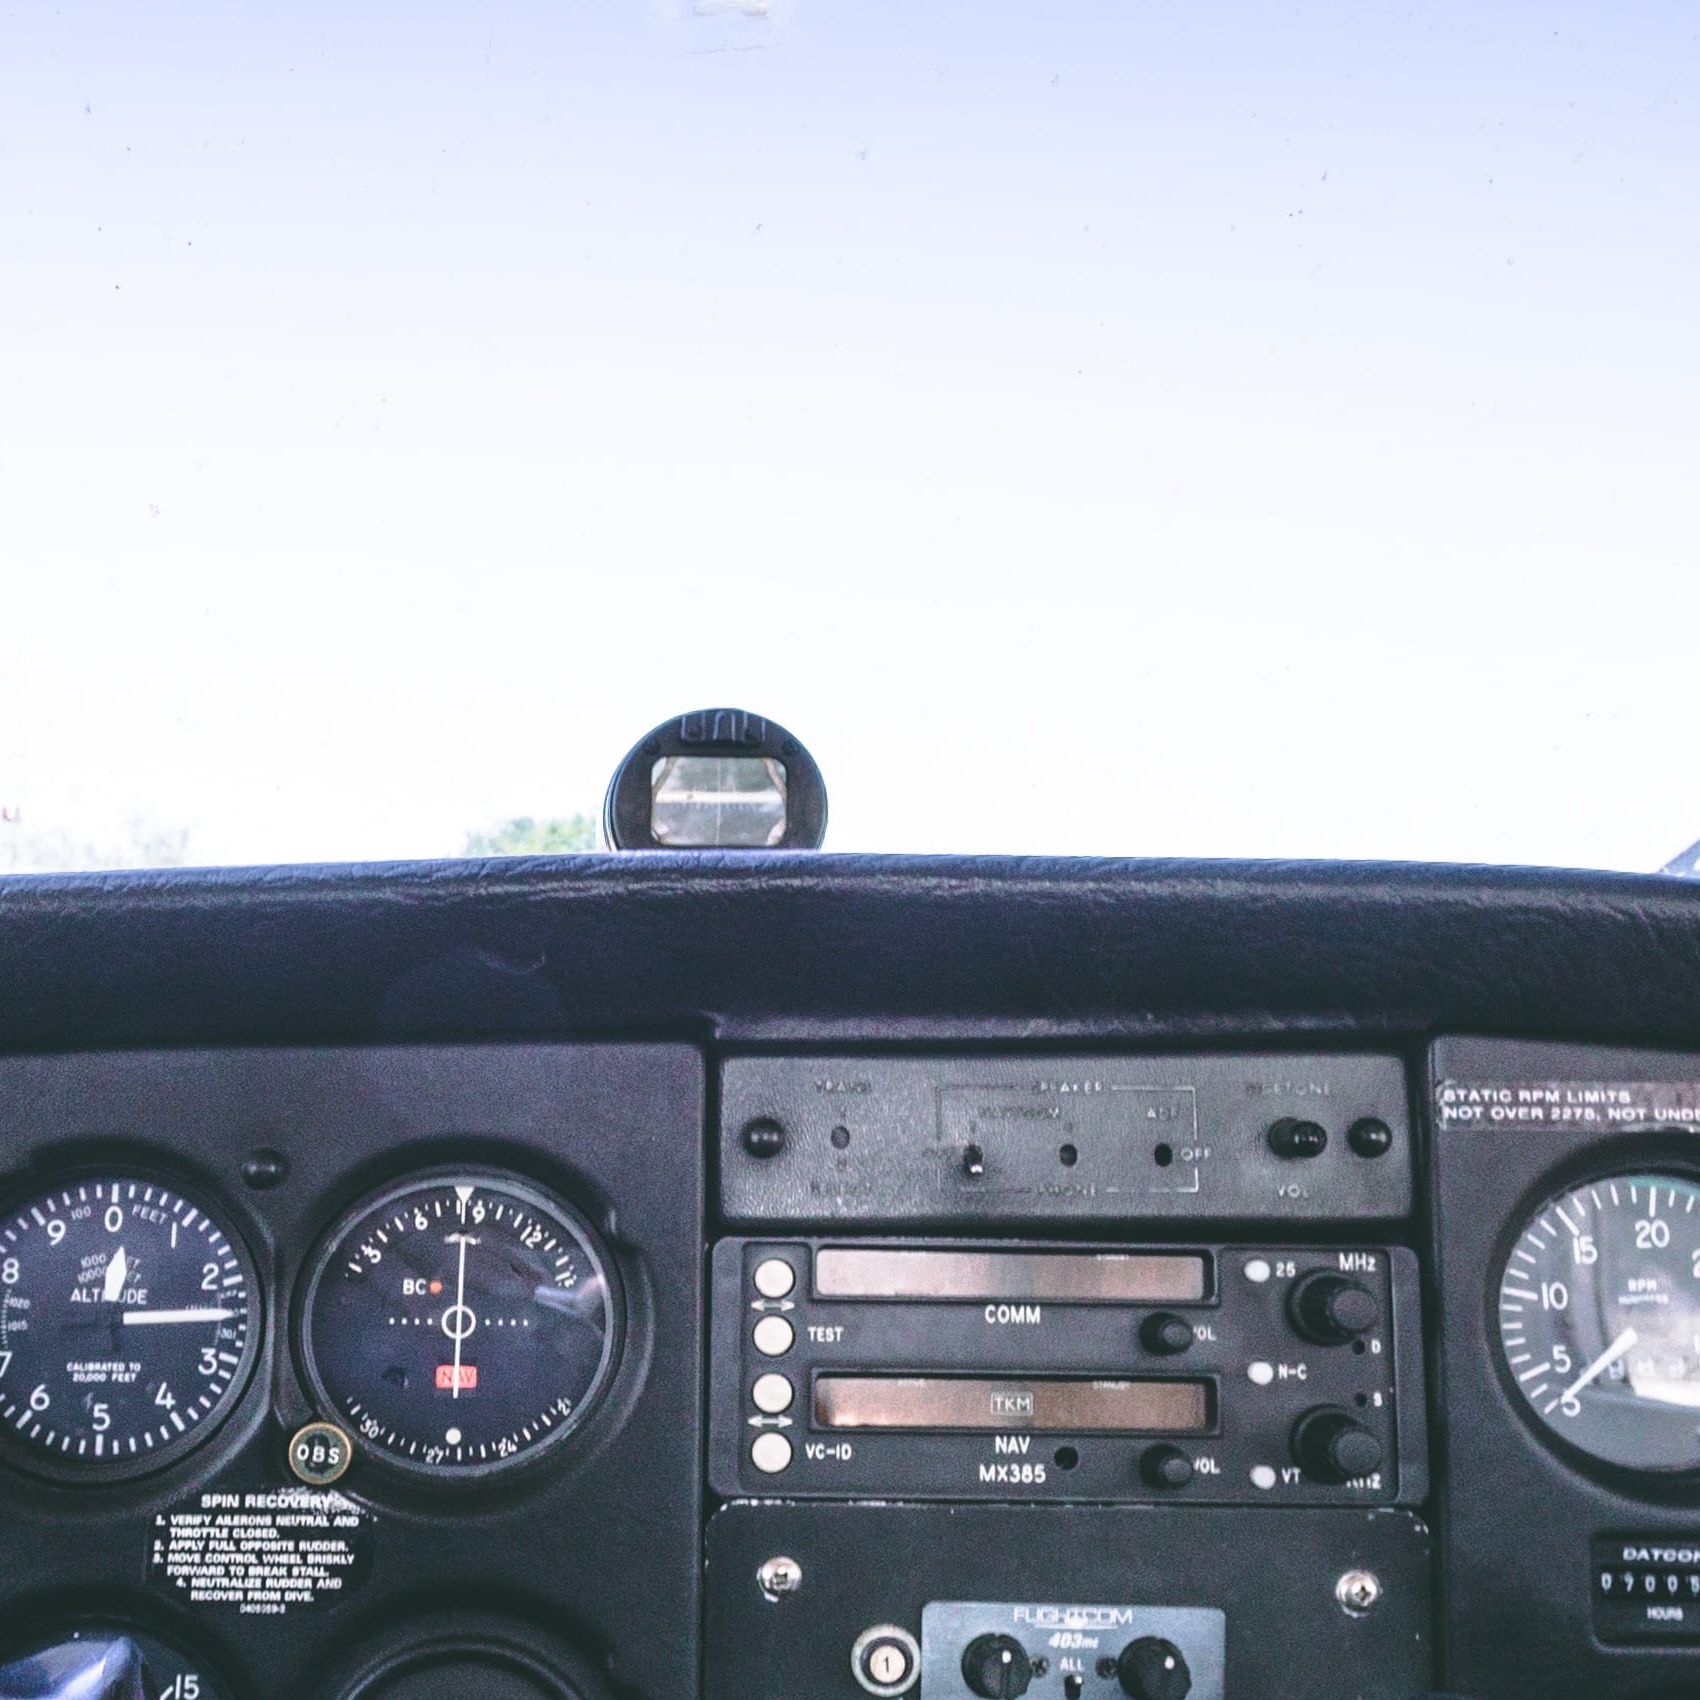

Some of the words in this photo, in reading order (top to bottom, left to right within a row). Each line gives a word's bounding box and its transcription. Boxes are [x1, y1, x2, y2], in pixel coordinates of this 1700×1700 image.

[1443, 1088, 1514, 1103] STATIC
[1519, 1088, 1560, 1103] RPM
[1566, 1088, 1631, 1104] LIMITS
[1443, 1106, 1486, 1120] NOT
[1492, 1106, 1543, 1121] OVER
[1608, 1106, 1647, 1121] NOT
[71, 1206, 92, 1221] 100
[132, 1205, 168, 1225] FEET
[105, 1206, 123, 1232] 0
[414, 1216, 428, 1231] 6
[47, 1220, 66, 1246] 9
[171, 1222, 178, 1249] 1
[1635, 1220, 1670, 1249] 20
[1573, 1237, 1598, 1265] 15
[2, 1258, 19, 1284] 8
[1275, 1263, 1297, 1277] 25
[1339, 1253, 1378, 1272] MHz
[201, 1263, 220, 1290] 2
[403, 1280, 427, 1296] BC
[1627, 1279, 1657, 1292] RPM
[70, 1288, 148, 1305] ALTUDE
[1541, 1282, 1568, 1310] 10
[984, 1304, 1041, 1324] COMM
[807, 1327, 844, 1343] TEST
[67, 1362, 125, 1372] CALIBRATED
[129, 1362, 141, 1372] TO
[198, 1348, 217, 1375] 3
[1553, 1345, 1571, 1373] 5
[112, 1373, 137, 1383] FEET
[1278, 1364, 1308, 1380] N-C
[30, 1384, 50, 1411] 6
[155, 1381, 175, 1408] 4
[993, 1396, 1032, 1412] TKM
[92, 1404, 110, 1431] 5
[296, 1443, 340, 1465] OBS
[805, 1443, 852, 1460] VC-ID
[995, 1436, 1031, 1455] NAV
[426, 1447, 444, 1464] 27
[979, 1464, 1047, 1484] MX385
[1281, 1468, 1301, 1484] VT
[201, 1494, 239, 1509] SPIN
[245, 1494, 330, 1509] RECOVERY
[171, 1515, 211, 1527] VERIFY
[215, 1515, 272, 1527] AILERONS
[275, 1515, 329, 1527] NEUTRAL
[333, 1515, 359, 1527] AND
[170, 1528, 228, 1539] THROTTLE
[232, 1528, 280, 1539] CLOSED.
[169, 1540, 205, 1551] APPLY
[209, 1540, 236, 1551] FULL
[240, 1540, 294, 1551] OPPOSITE
[298, 1540, 348, 1551] RUDDER.
[167, 1553, 201, 1565] MOVE
[204, 1553, 258, 1565] CONTROL
[262, 1553, 302, 1565] WHEEL
[307, 1553, 354, 1565] BRISKLY
[167, 1566, 225, 1577] FORWARD
[229, 1566, 244, 1577] TO
[248, 1566, 287, 1577] BREAK
[292, 1566, 329, 1577] STALL.
[191, 1578, 261, 1589] NEUTRALIZE
[265, 1578, 312, 1589] RUDDER
[316, 1578, 342, 1589] AND
[191, 1591, 243, 1602] RECOVER
[247, 1591, 281, 1602] FROM
[285, 1591, 314, 1602] DIVE.
[1014, 1607, 1133, 1627] FLIGHTCOM
[1647, 1606, 1684, 1621] HOURS
[1060, 1657, 1085, 1671] ALL
[175, 1674, 199, 1700] 15
